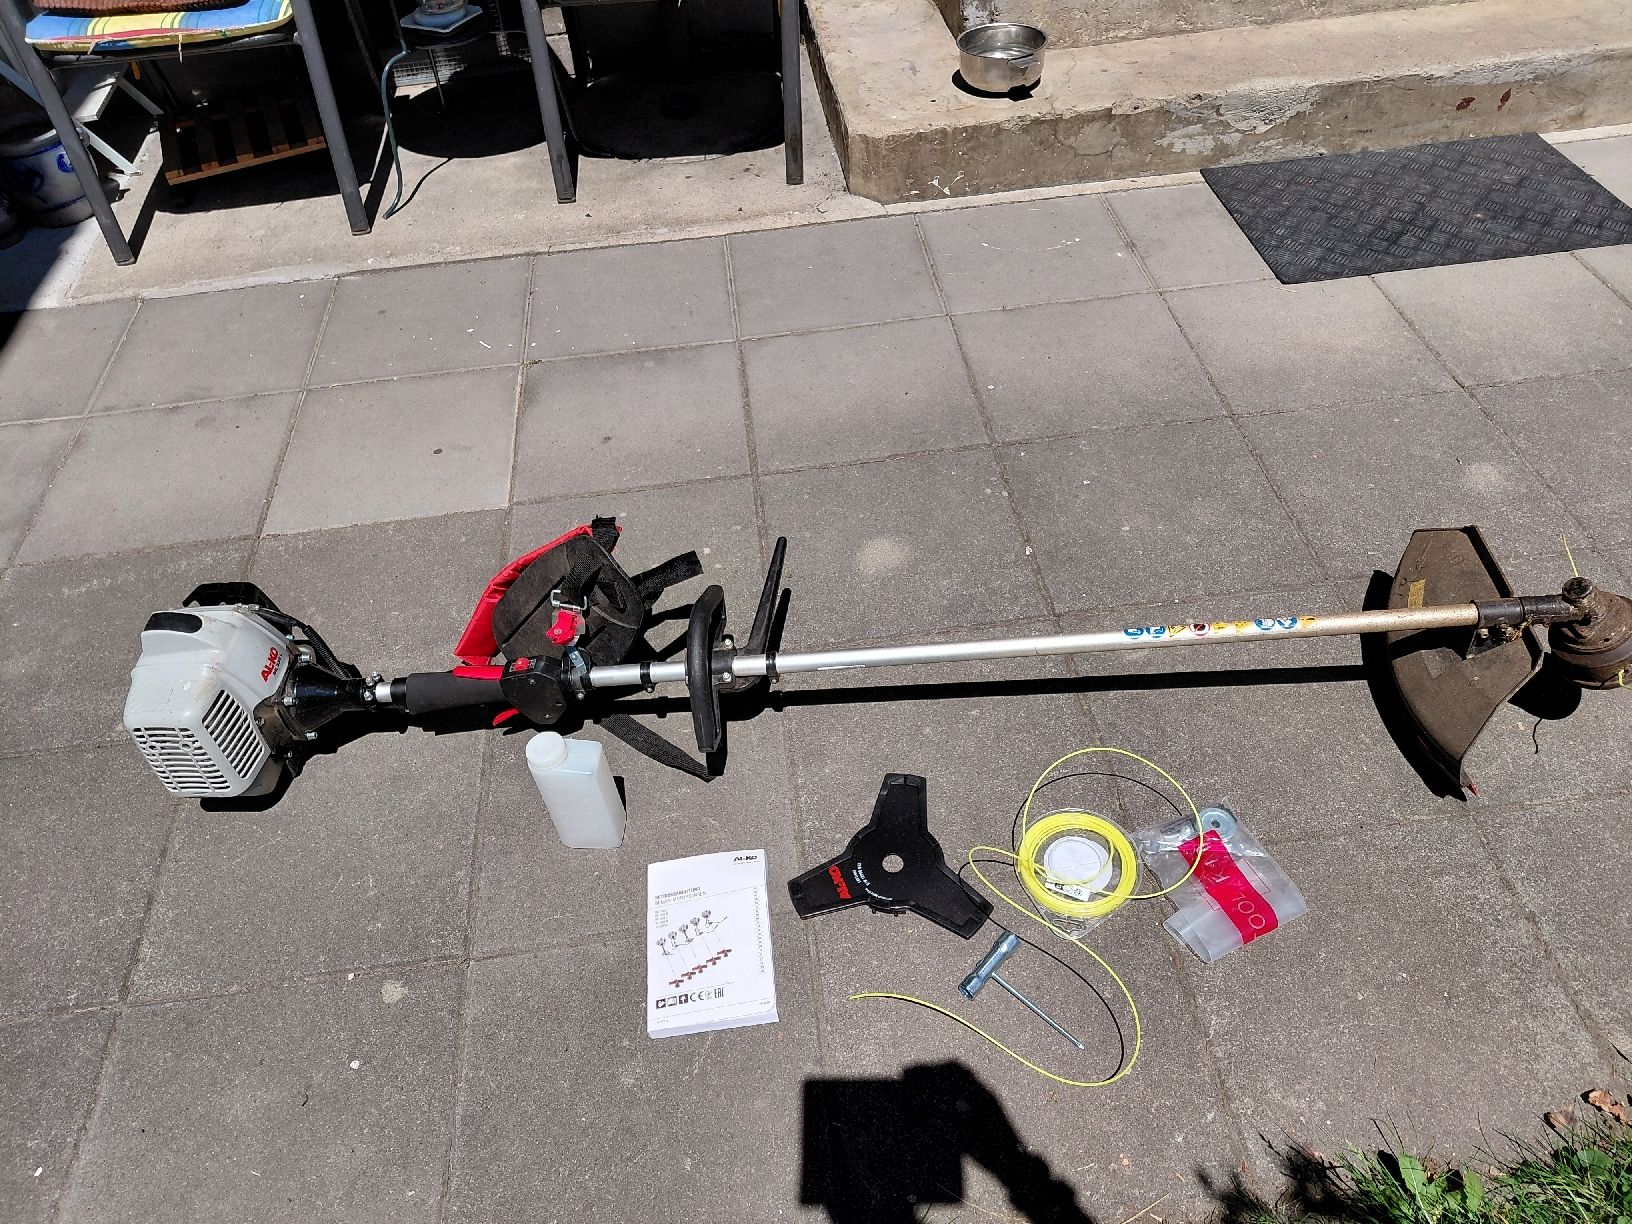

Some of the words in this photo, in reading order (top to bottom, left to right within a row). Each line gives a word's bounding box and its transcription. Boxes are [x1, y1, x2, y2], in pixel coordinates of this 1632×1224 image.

[261, 646, 279, 682] AL-KO
[828, 864, 852, 899] AL-KO
[1231, 893, 1266, 941] OOL
